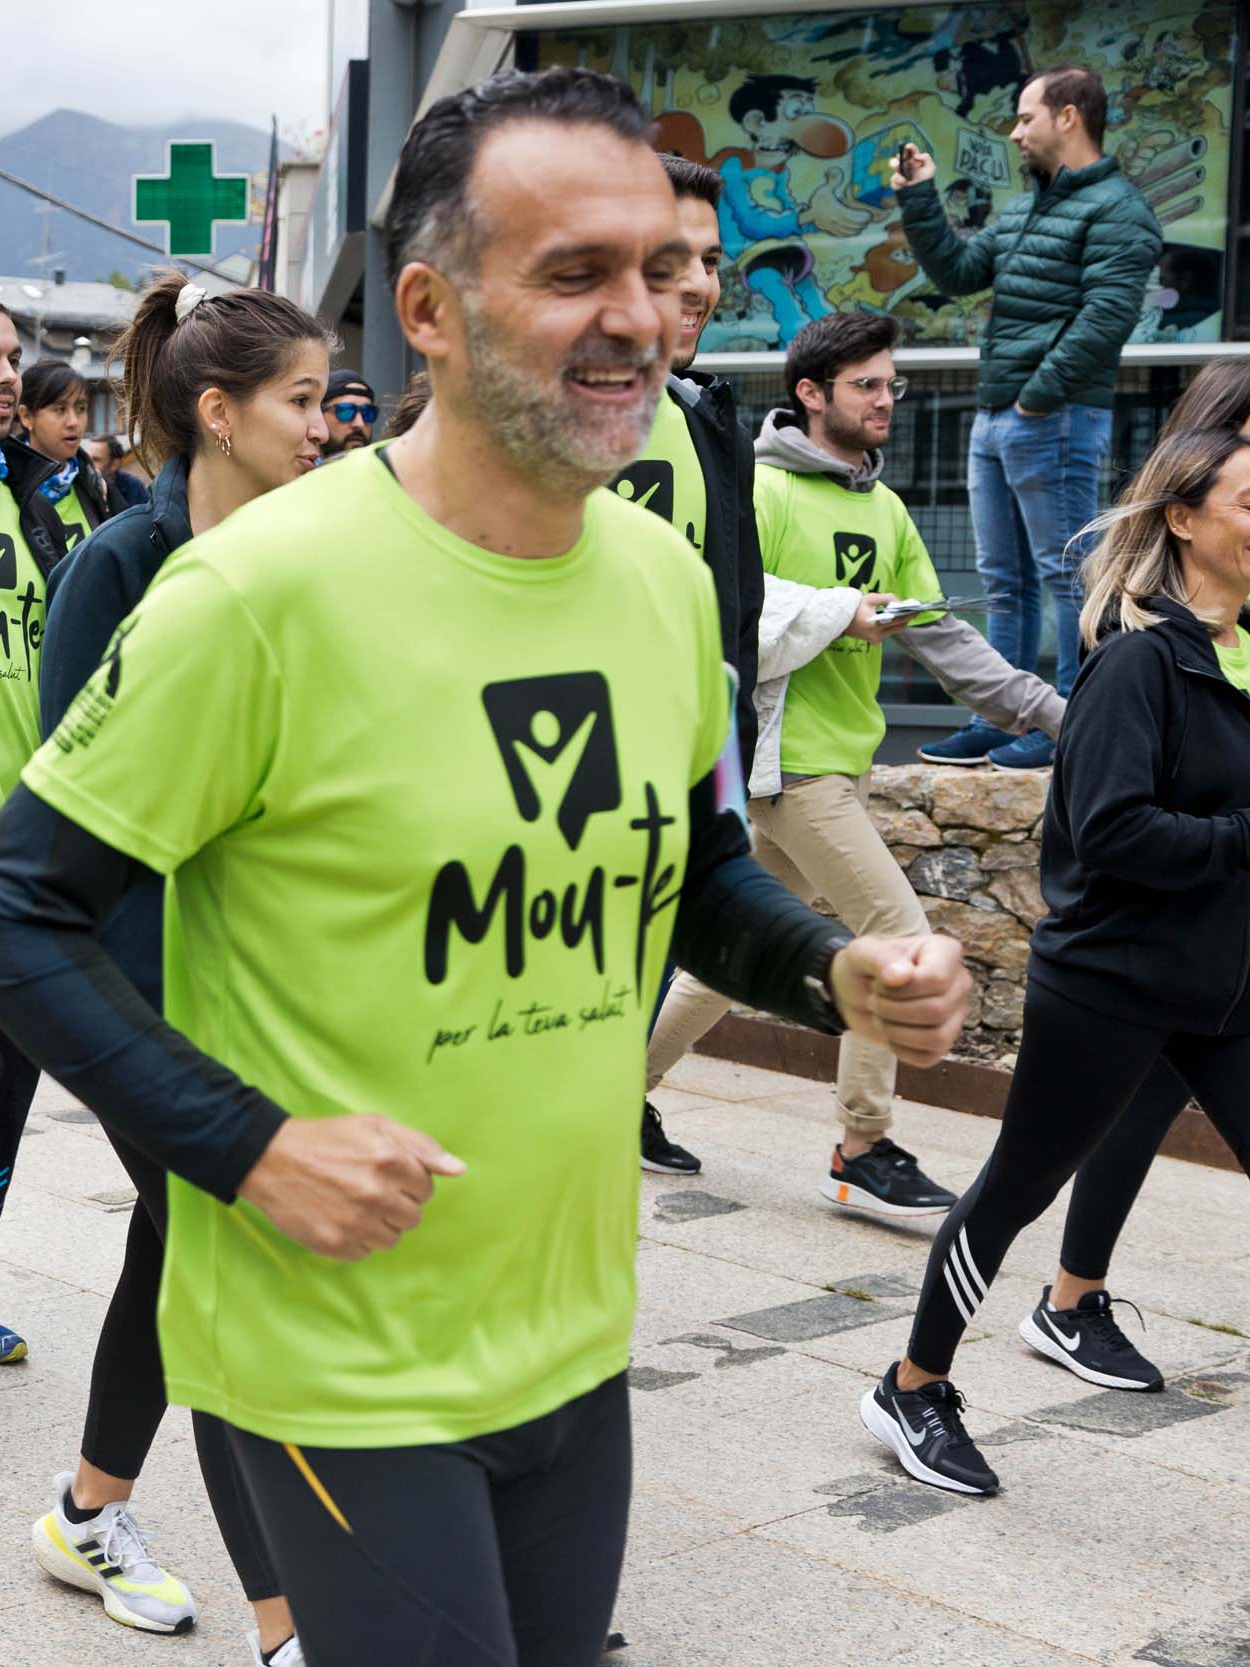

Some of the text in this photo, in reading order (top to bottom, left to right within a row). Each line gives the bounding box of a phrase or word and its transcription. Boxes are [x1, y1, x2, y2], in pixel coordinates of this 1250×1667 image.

[424, 781, 681, 1008] Mou-te
[426, 979, 632, 1065] per la teva salut
